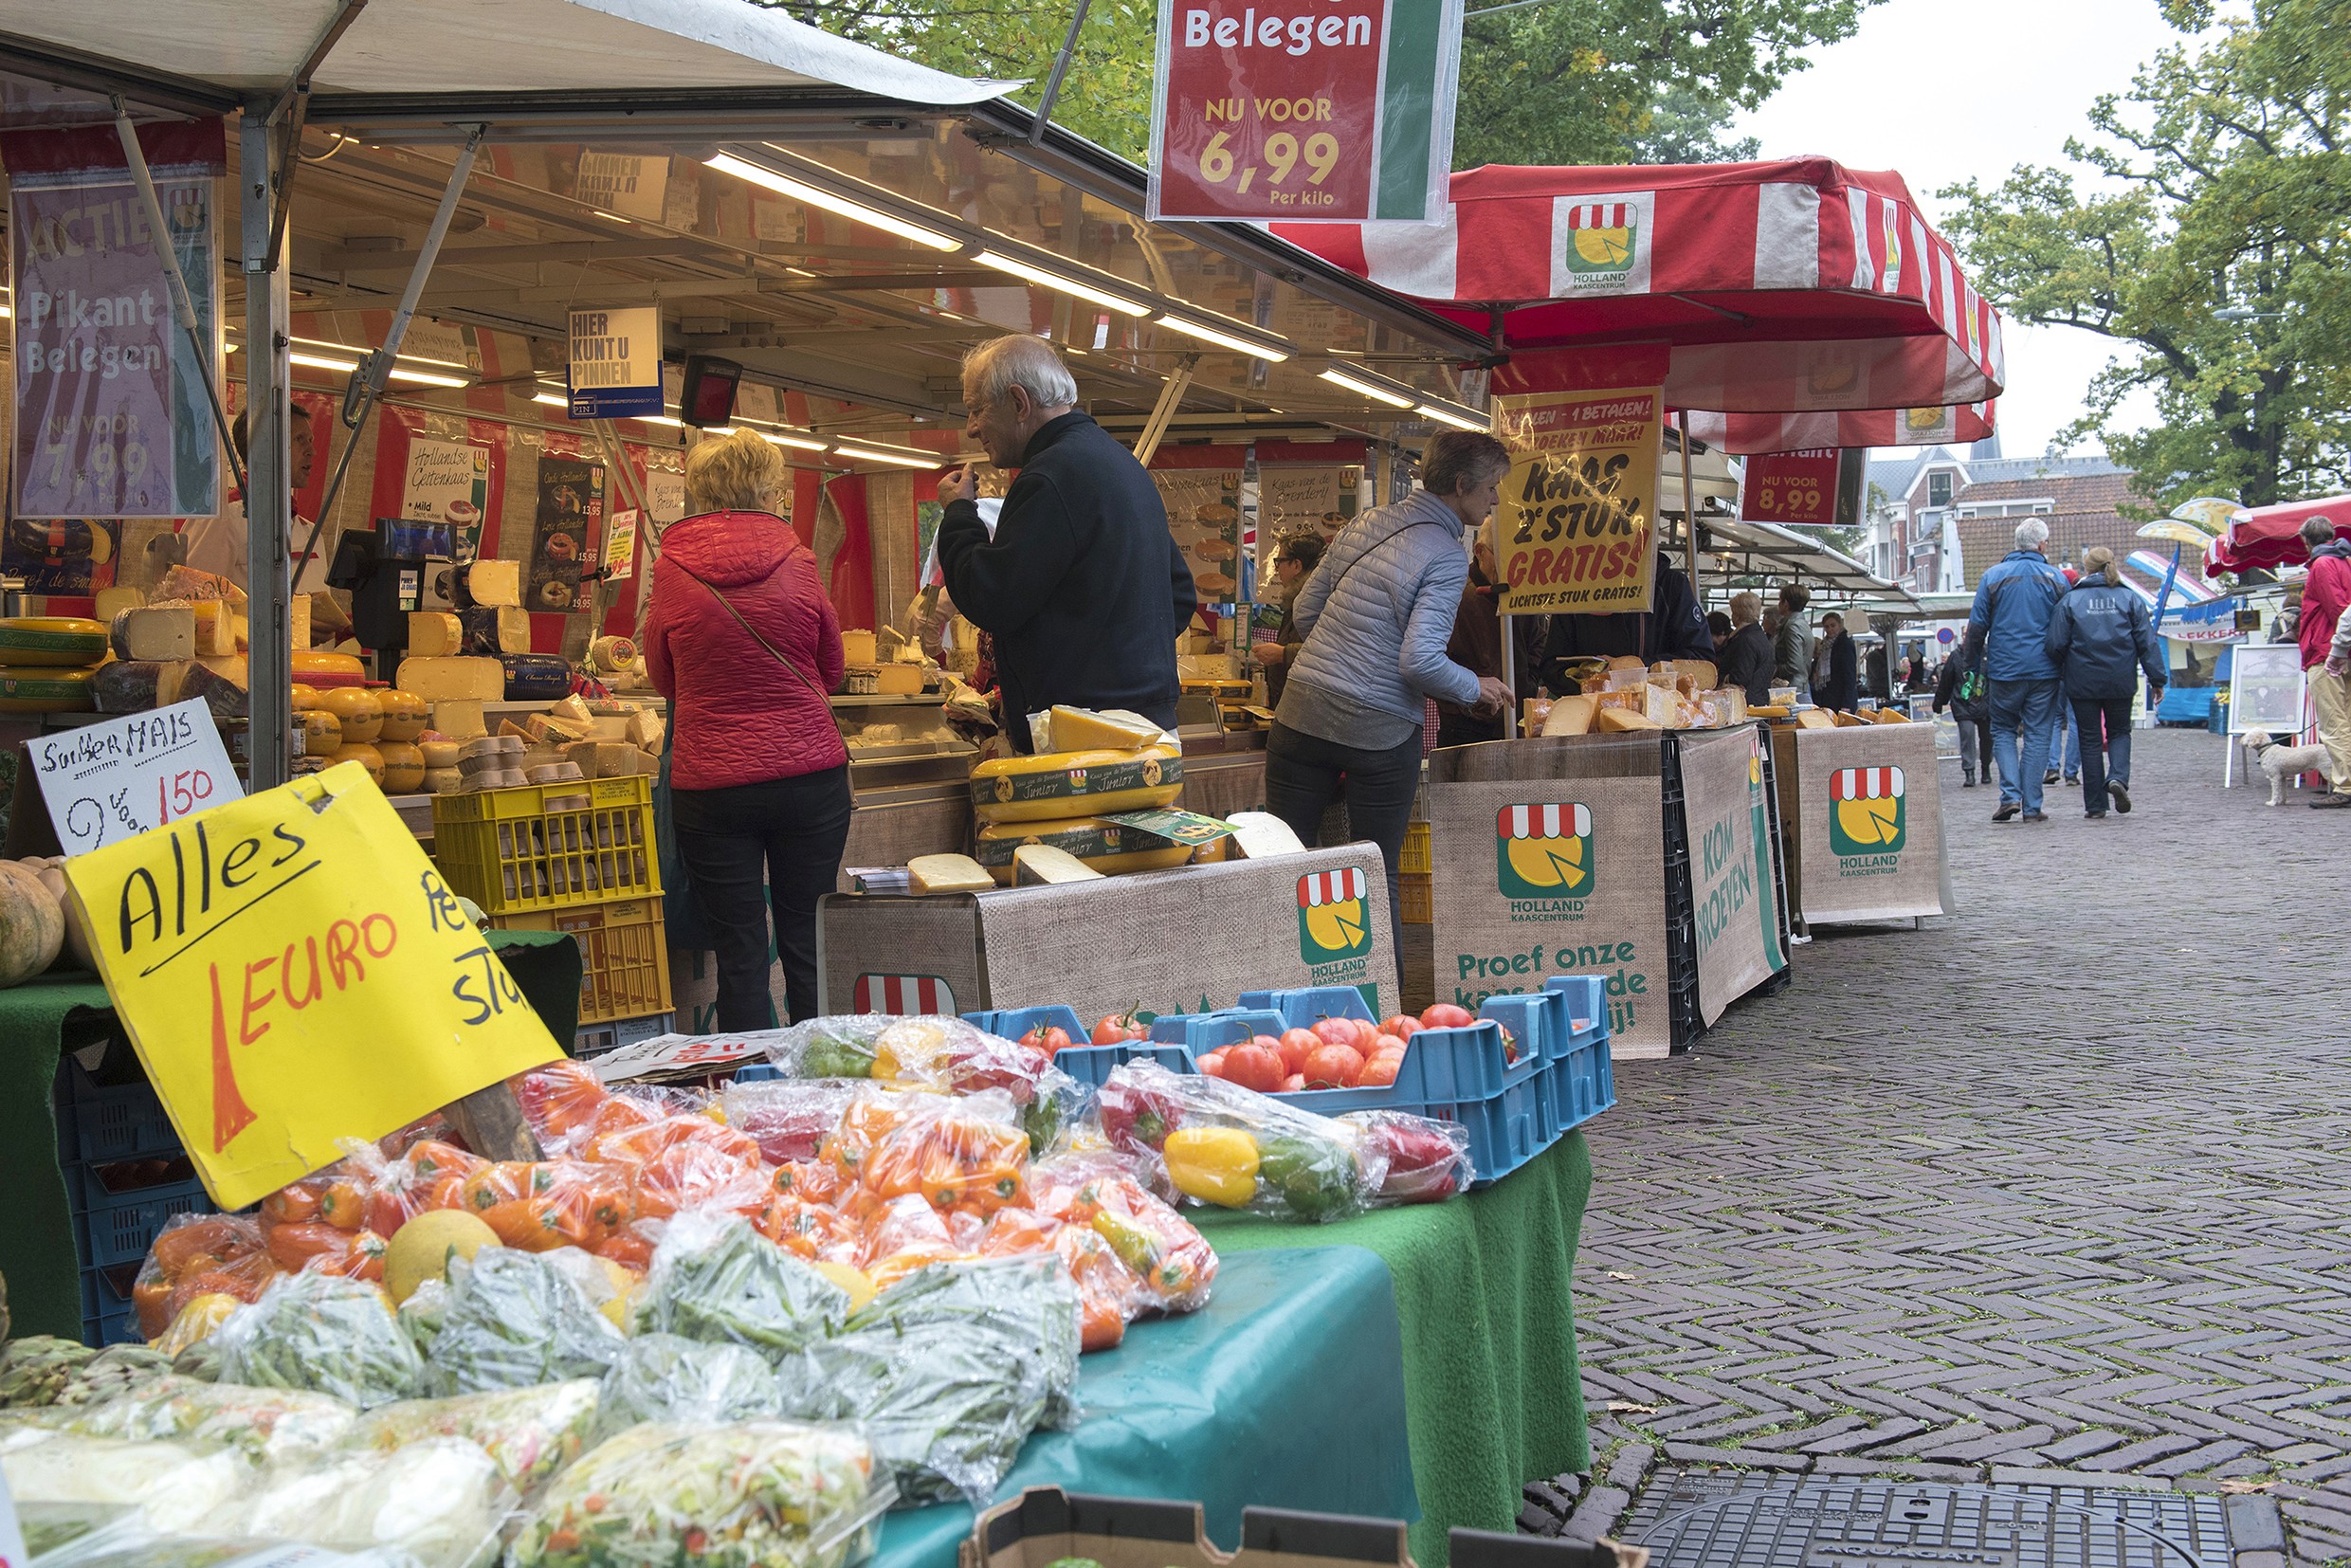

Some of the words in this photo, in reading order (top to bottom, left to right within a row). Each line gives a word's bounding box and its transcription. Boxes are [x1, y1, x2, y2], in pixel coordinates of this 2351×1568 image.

[1185, 8, 1372, 56] Belegen
[1205, 99, 1244, 121] NU
[1255, 98, 1332, 121] VOOR
[1199, 131, 1340, 193] 6,99
[1269, 191, 1296, 206] Per
[1302, 191, 1334, 206] kilo
[26, 195, 155, 265] ACTIE
[1574, 273, 1626, 283] HOLLAND
[30, 288, 155, 330] Pikant
[572, 314, 608, 337] HIER
[26, 339, 161, 379] Belegen
[573, 337, 614, 361] KUNT
[618, 337, 629, 359] U
[573, 362, 631, 385] PINNEN
[1572, 408, 1579, 421] 1
[1582, 400, 1651, 421] BETALEN!
[48, 415, 73, 435] NU
[82, 414, 139, 435] VOOR
[1592, 425, 1645, 445] MAAR!
[414, 447, 468, 465] Hollandse
[46, 442, 148, 496] 7,99
[411, 467, 470, 491] Geitenkaas
[1522, 453, 1630, 502] KAAS
[1298, 479, 1315, 488] van
[1762, 476, 1780, 486] NU
[1784, 477, 1818, 487] VOOR
[99, 491, 118, 504] Per
[122, 491, 146, 504] kilo
[414, 501, 432, 512] Mild
[1759, 488, 1821, 515] 8,99
[582, 505, 601, 517] 13,95
[1540, 497, 1640, 542] STUK
[577, 552, 597, 563] 15,95
[1507, 528, 1650, 589] GRATIS!
[572, 598, 592, 610] 19,95
[1508, 593, 1556, 609] LICHTSTE
[1558, 590, 1590, 604] STUK
[1593, 586, 1643, 601] GRATIS!
[126, 712, 192, 757] MAIS
[1023, 783, 1058, 799] Junior
[1099, 775, 1134, 792] Junior
[159, 770, 213, 826] 150
[1703, 811, 1734, 884] KOM
[1840, 855, 1898, 868] HOLLAND
[1840, 867, 1898, 877] KAASCENTRUM
[121, 821, 306, 955] Alles
[1511, 901, 1584, 912] HOLLAND
[1696, 853, 1752, 960] PROEVEN
[1311, 958, 1366, 977] HOLLAND
[1457, 944, 1544, 980] Proef
[1555, 941, 1636, 969] onze
[240, 913, 397, 1047] EURO
[1312, 971, 1367, 987] KAASCENTRUM
[1606, 969, 1648, 996] de
[1817, 1542, 2001, 1565] AQUAGATE
